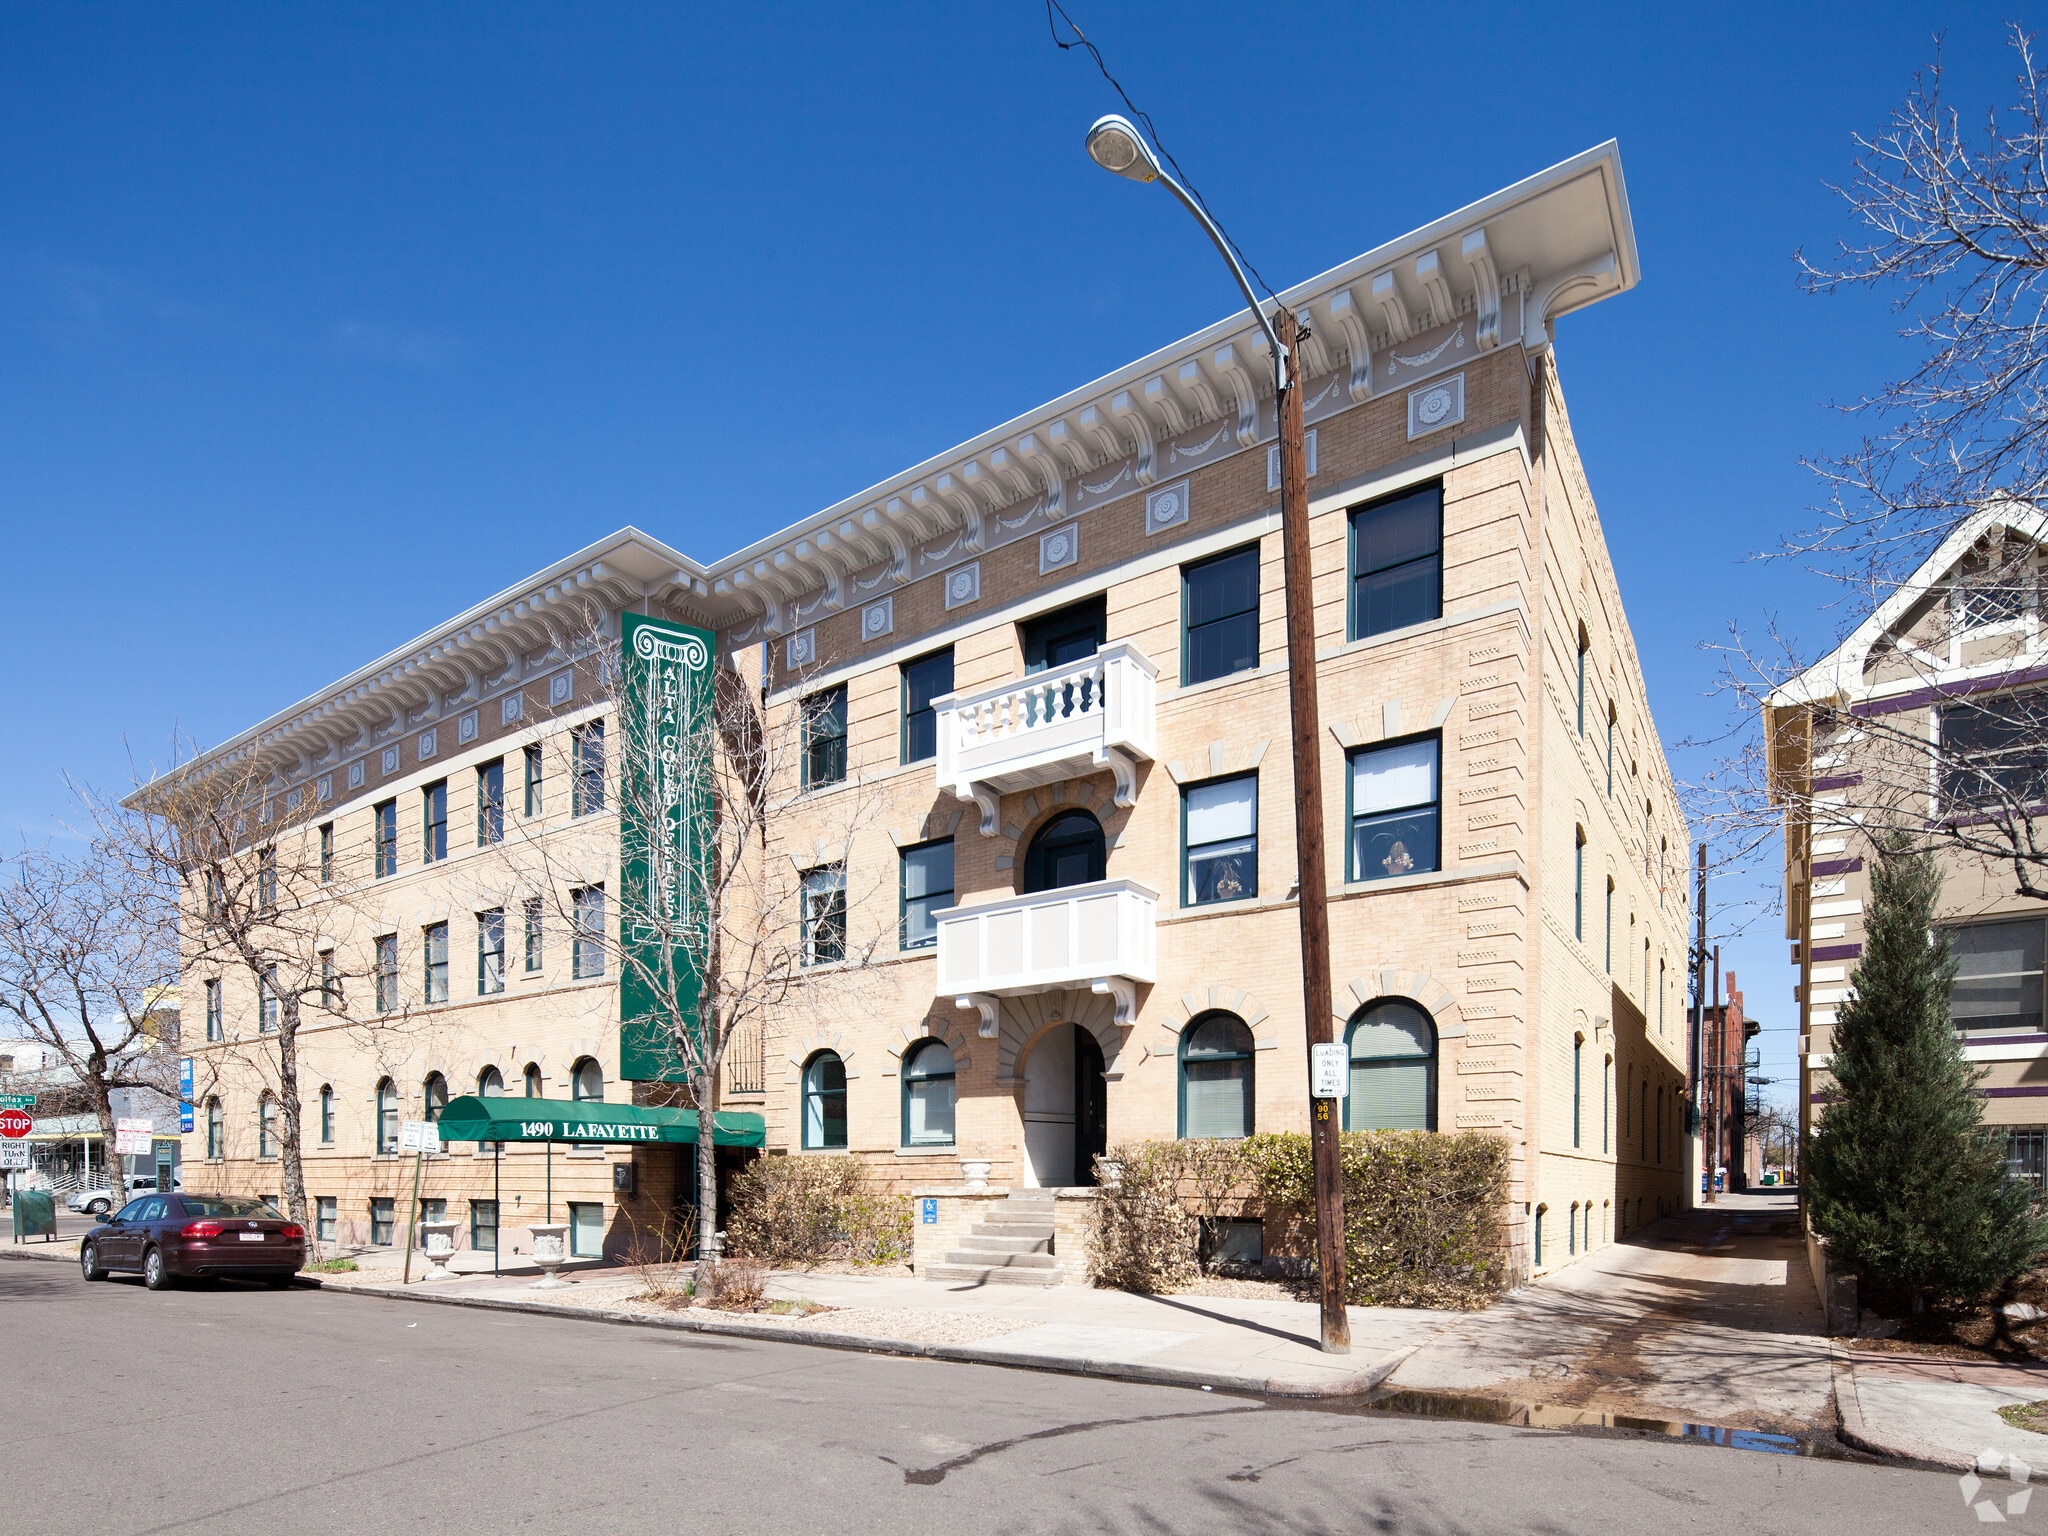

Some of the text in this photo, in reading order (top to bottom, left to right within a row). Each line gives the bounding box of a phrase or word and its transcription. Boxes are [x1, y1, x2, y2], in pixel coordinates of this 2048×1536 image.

[663, 666, 677, 724] ALTA
[662, 734, 677, 806] COURT
[1315, 1049, 1345, 1057] LOADING
[1321, 1059, 1339, 1067] ONLY
[1321, 1079, 1341, 1087] TIMES
[1317, 1105, 1329, 1113] 90
[0, 1118, 31, 1130] STOP
[520, 1121, 659, 1140] 1490 LAFAYETTE
